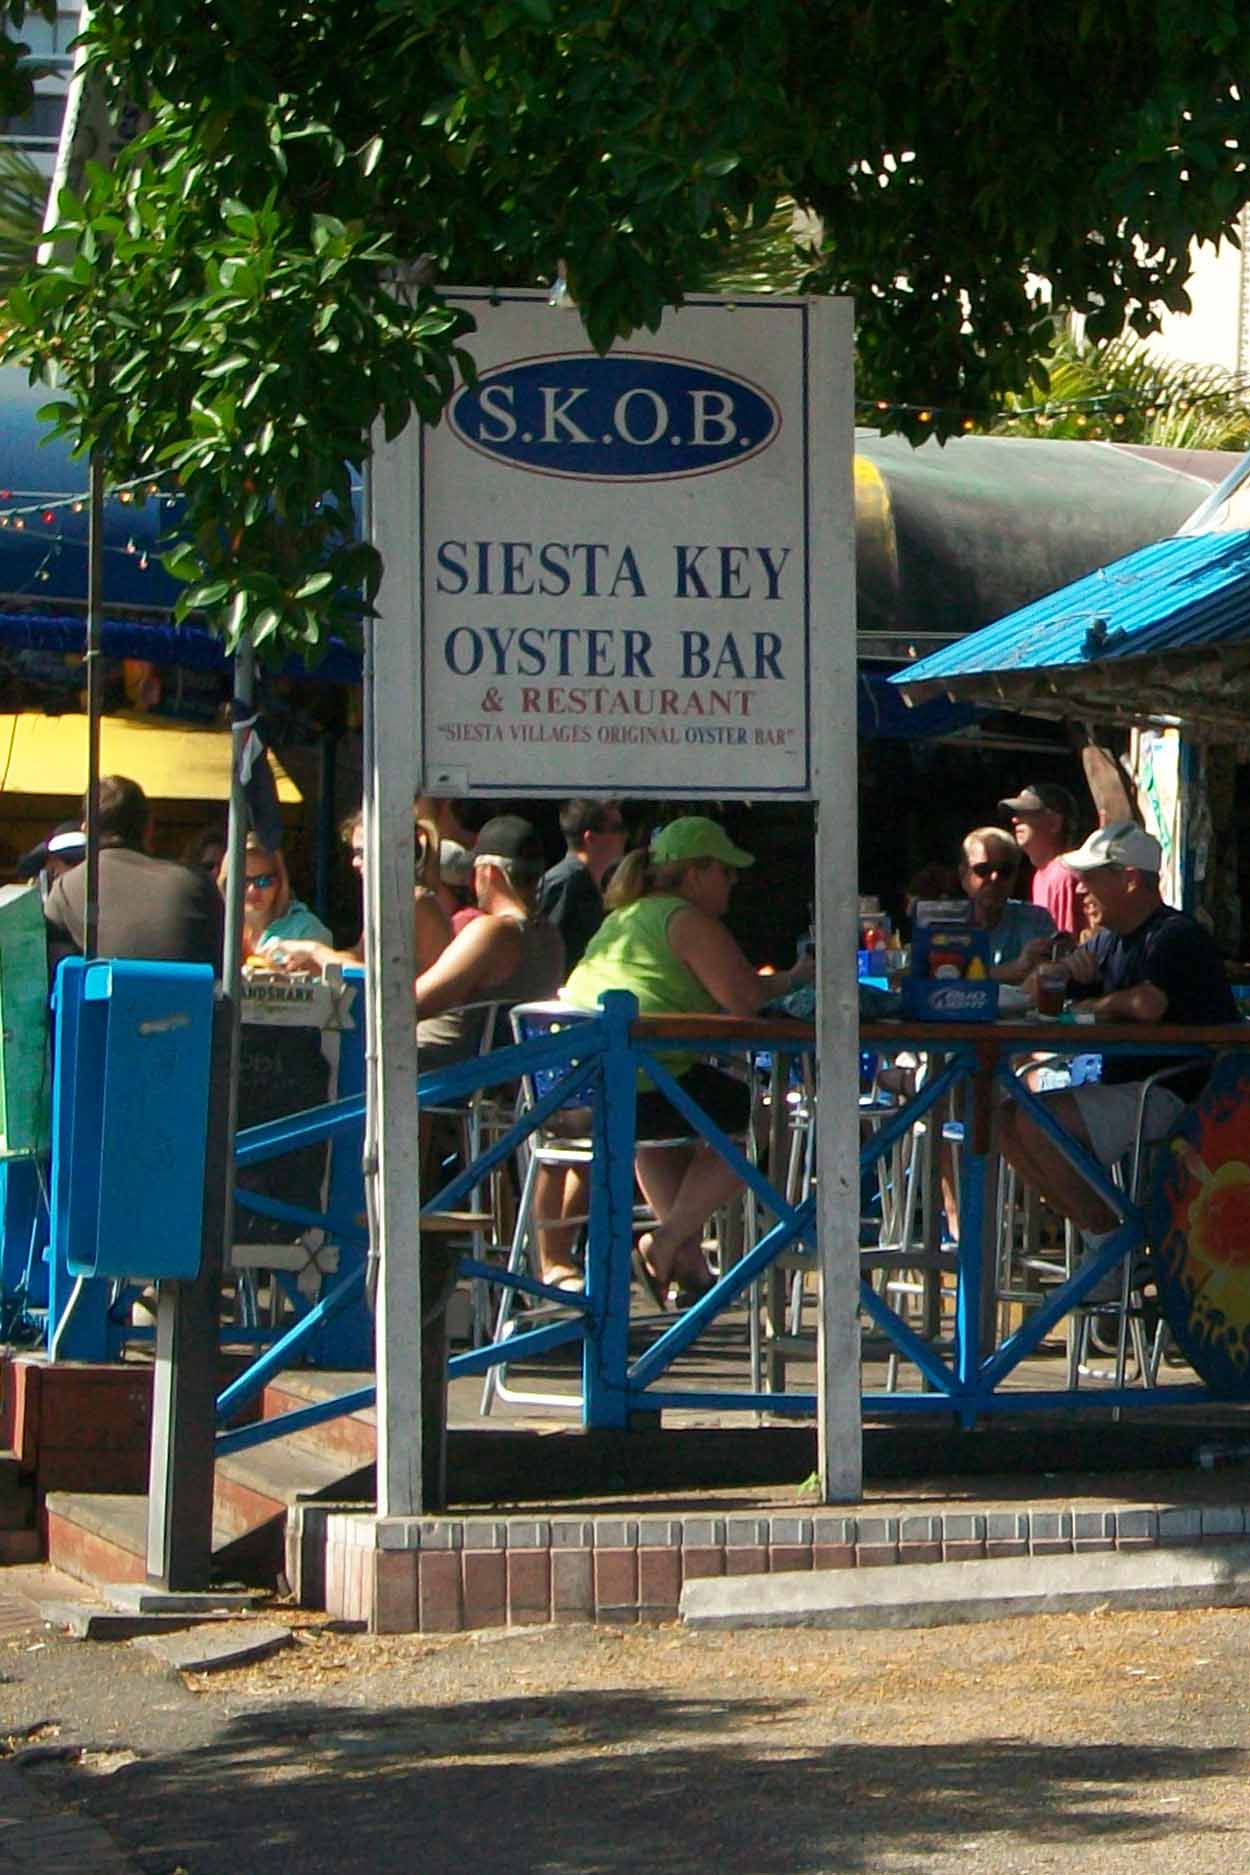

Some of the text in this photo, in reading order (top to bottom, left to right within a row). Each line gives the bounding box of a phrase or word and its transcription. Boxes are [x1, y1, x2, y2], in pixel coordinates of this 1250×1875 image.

[478, 384, 752, 448] S.K.O.B.
[436, 540, 792, 600] SIESTA KEY
[443, 626, 788, 681] OYSTER BAR
[480, 687, 757, 718] & RESTAURANT
[509, 724, 592, 745] VILLAGES
[597, 725, 681, 746] ORIGINAL
[685, 725, 749, 747] OYSTER
[239, 984, 315, 1002] ANDSHARK
